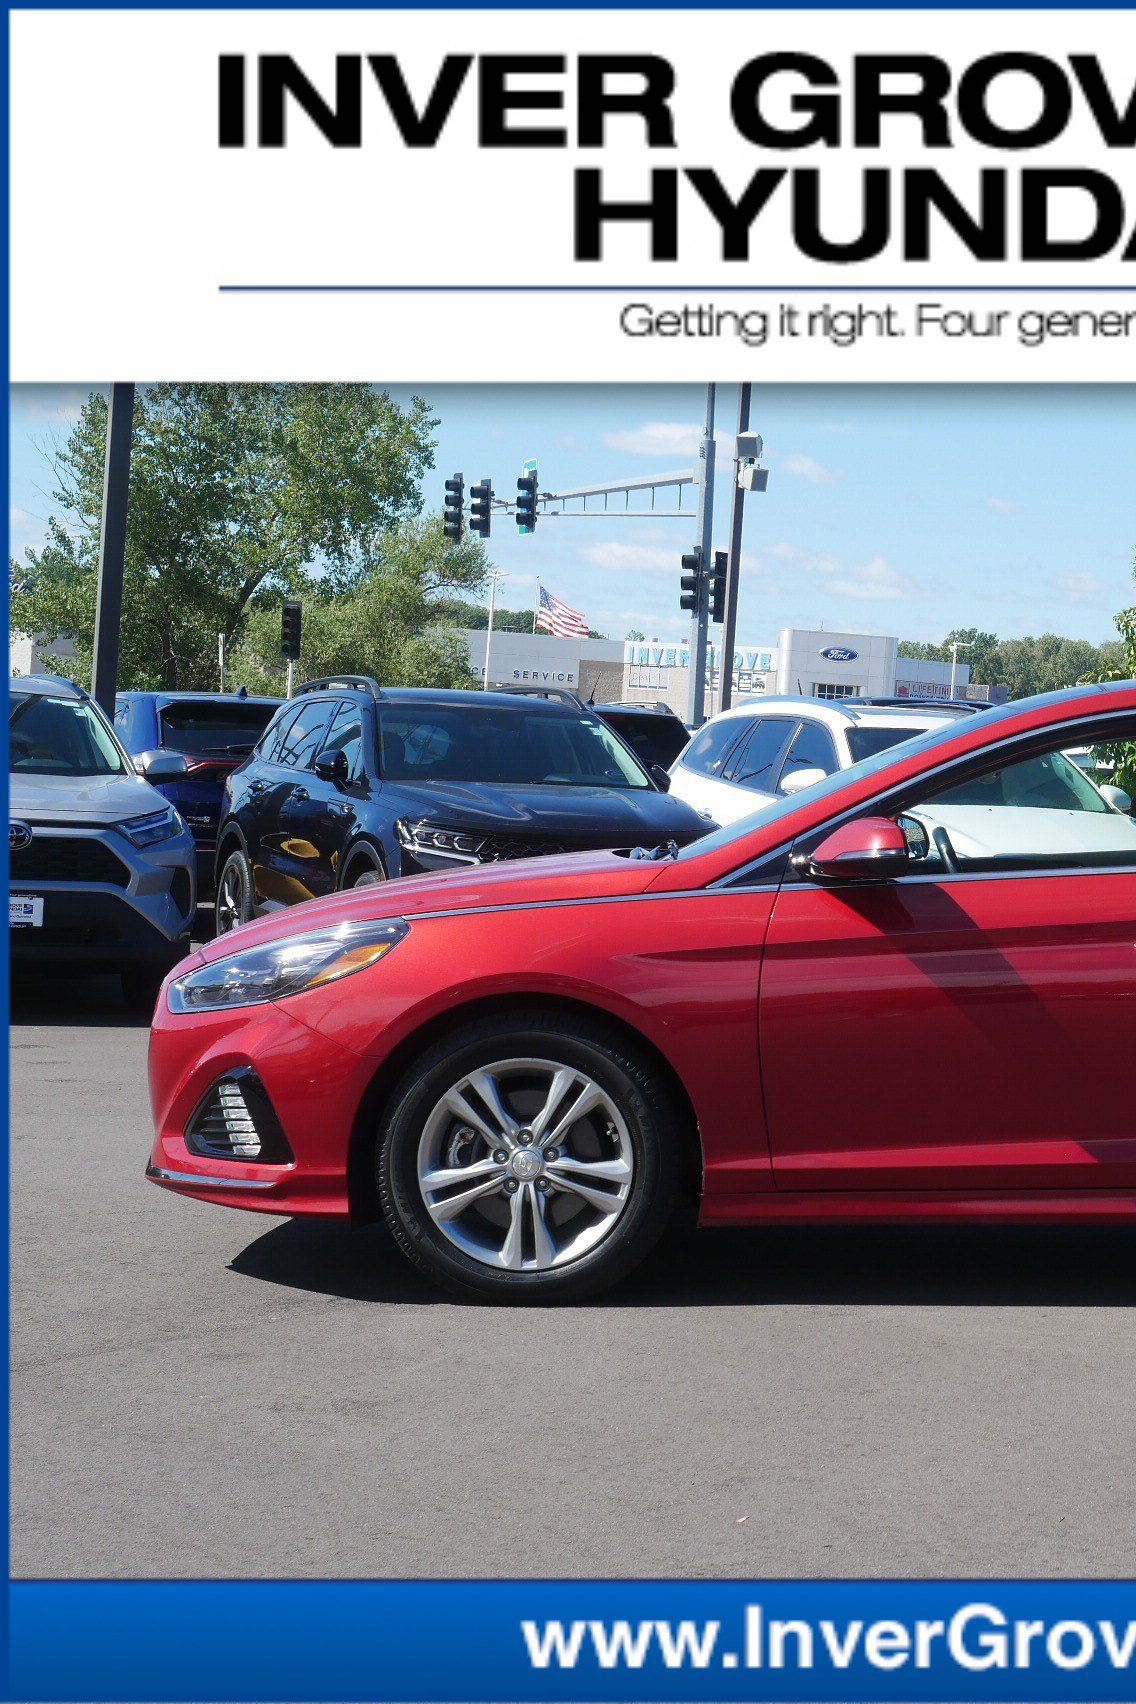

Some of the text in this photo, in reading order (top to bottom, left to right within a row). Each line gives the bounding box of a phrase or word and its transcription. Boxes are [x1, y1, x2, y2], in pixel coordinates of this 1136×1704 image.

[628, 646, 690, 666] INVER
[828, 649, 851, 661] Ford
[513, 669, 574, 683] SERVICE
